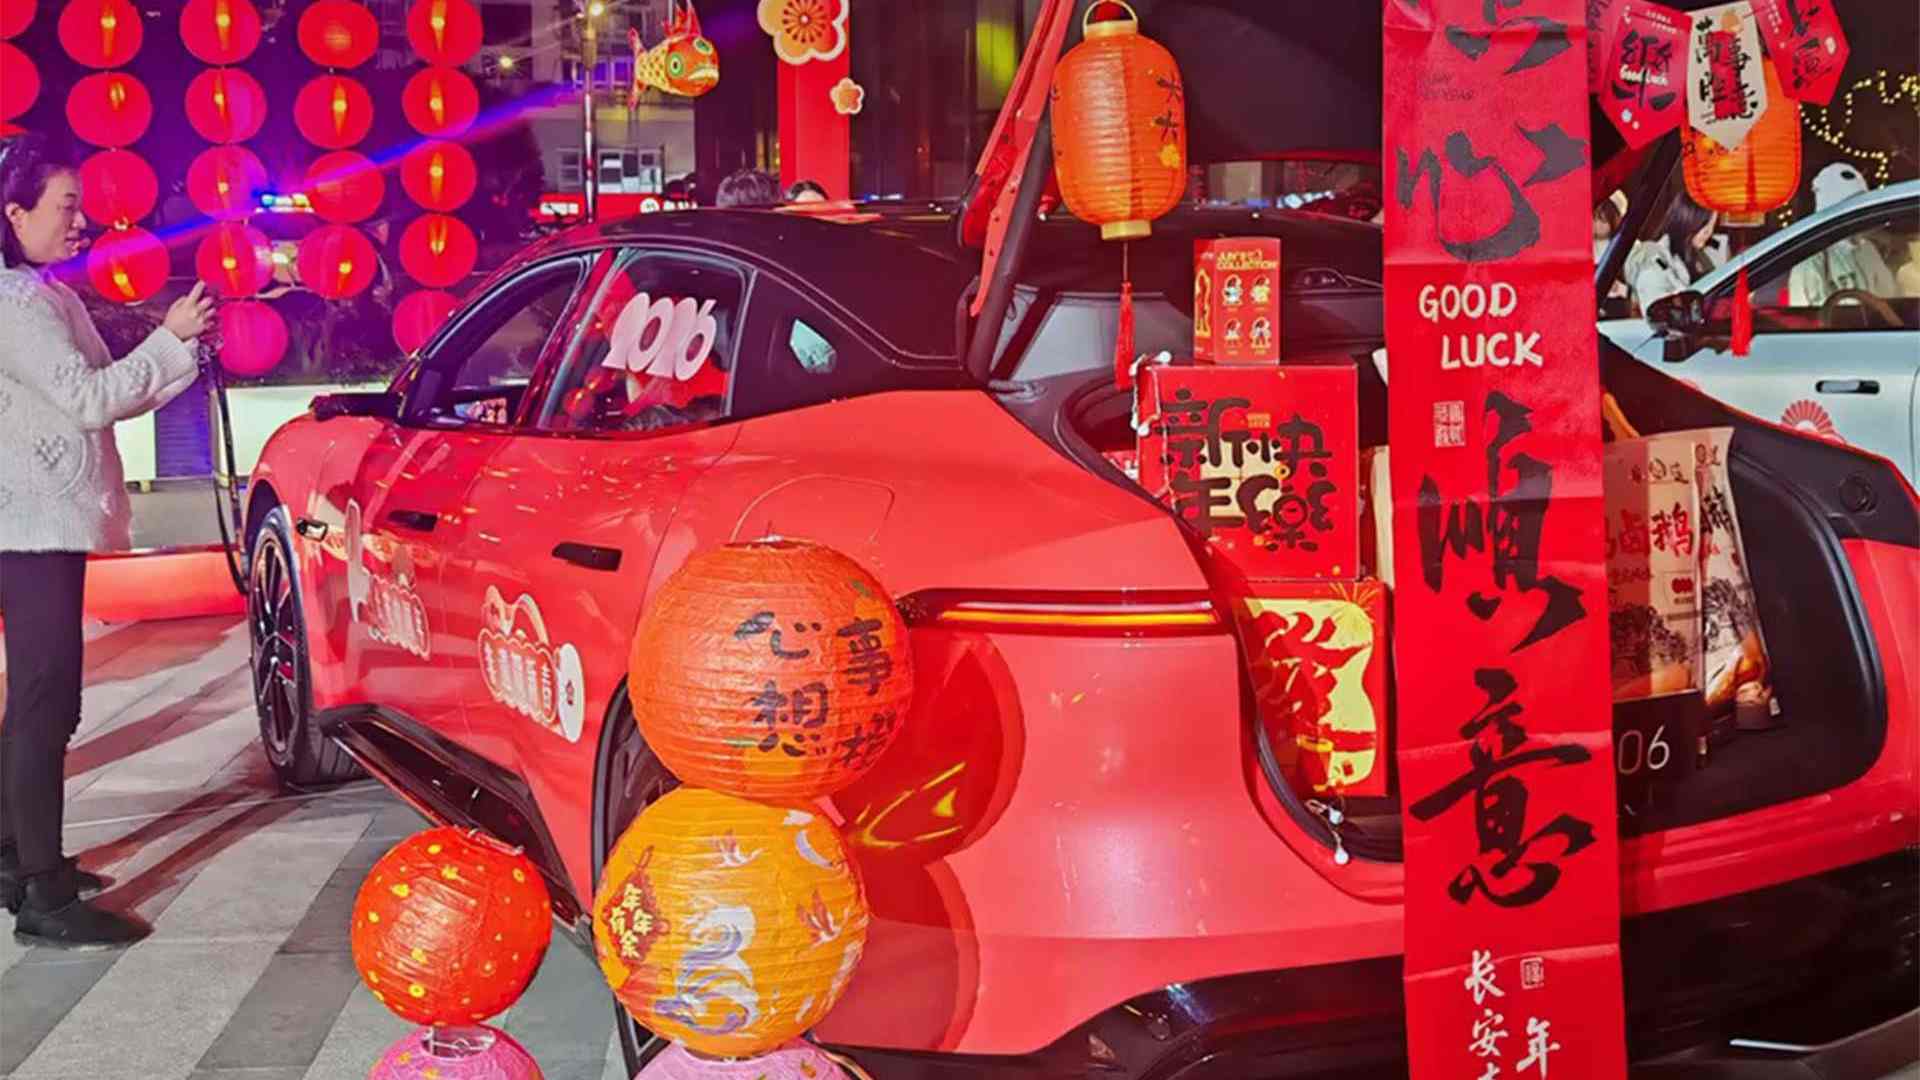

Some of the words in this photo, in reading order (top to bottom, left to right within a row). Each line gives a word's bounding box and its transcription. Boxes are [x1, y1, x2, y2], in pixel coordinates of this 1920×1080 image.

[1418, 282, 1517, 323] GOOD
[1441, 331, 1543, 370] LUCK
[1618, 725, 1670, 775] 06
[1516, 1016, 1561, 1080] 年
